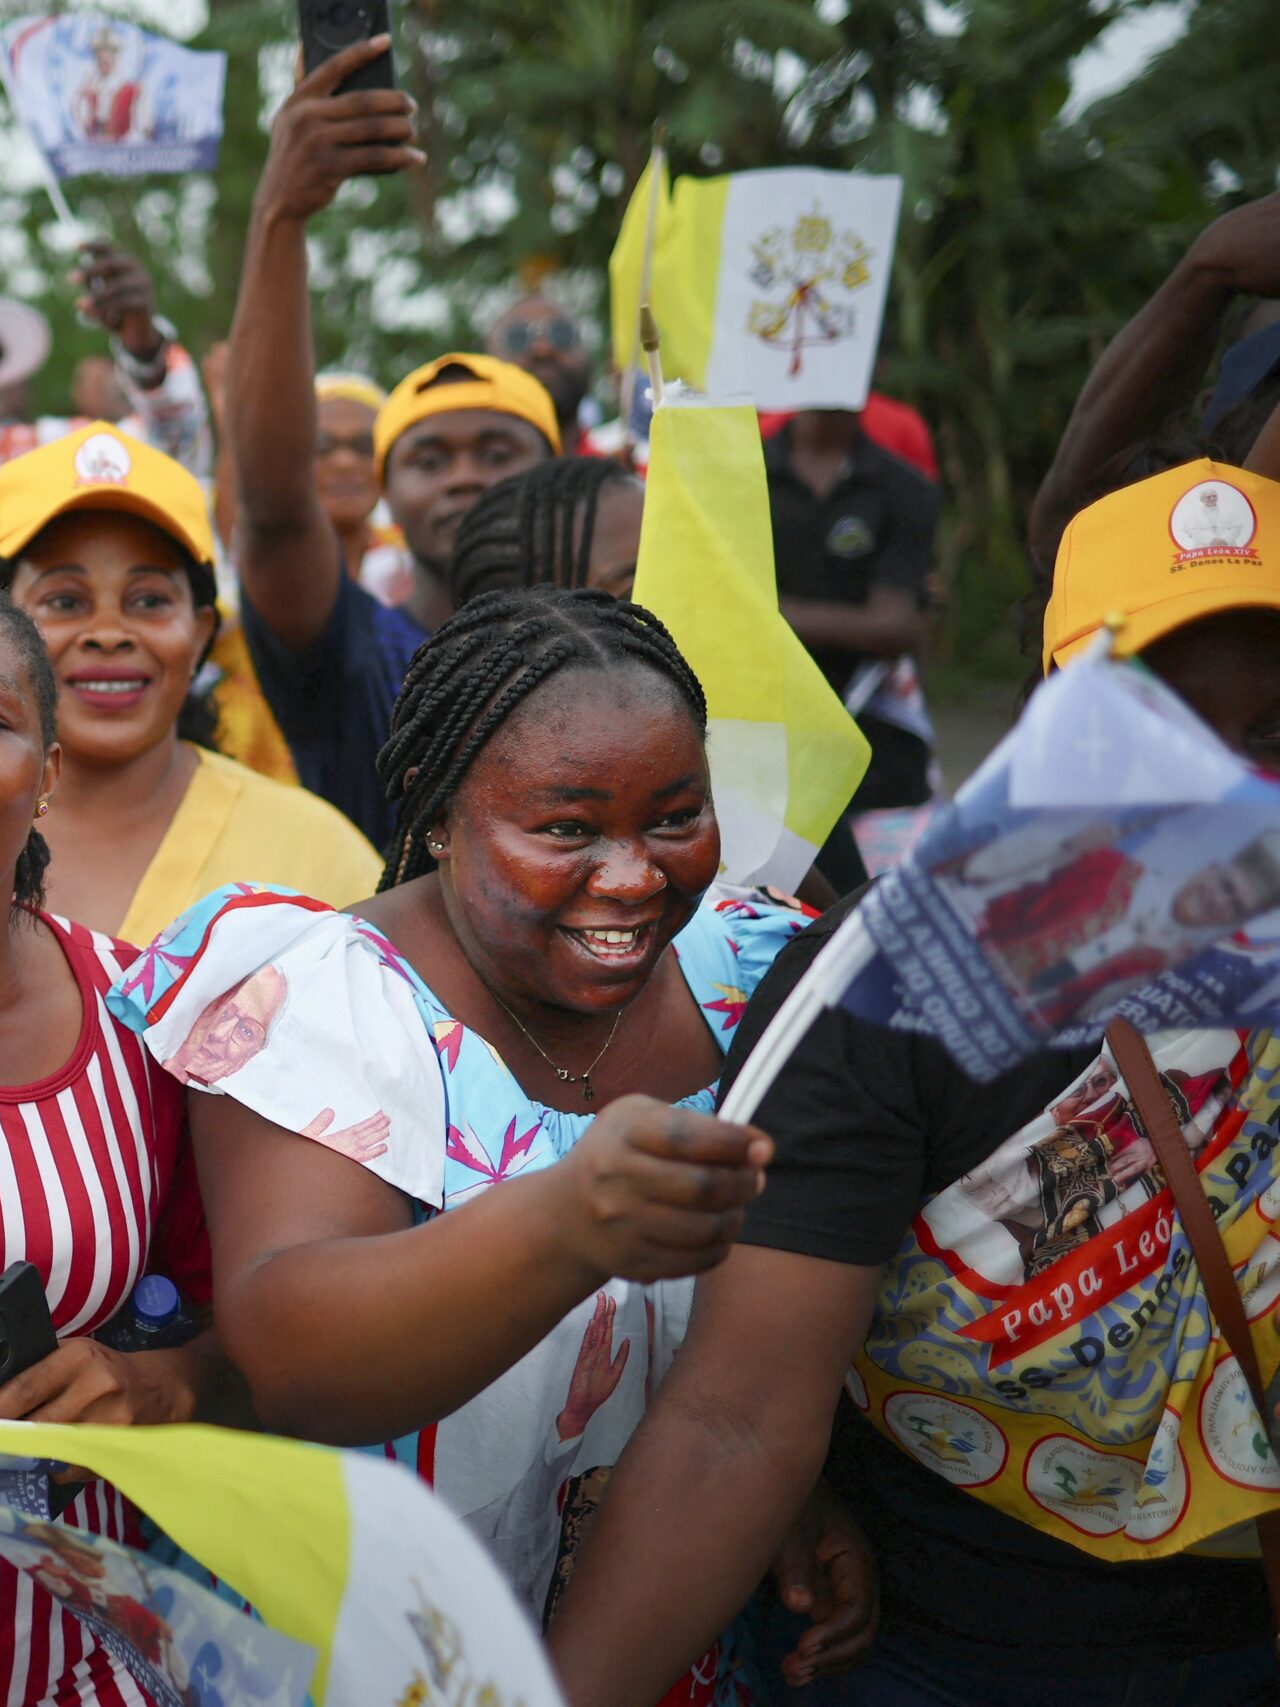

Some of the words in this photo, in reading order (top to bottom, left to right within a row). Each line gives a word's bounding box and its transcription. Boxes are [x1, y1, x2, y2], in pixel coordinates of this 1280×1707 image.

[1170, 564, 1187, 573] SS.
[1190, 558, 1224, 567] Denos
[1243, 558, 1263, 566] Paz
[1180, 550, 1204, 560] Papa
[1000, 1266, 1103, 1343] Papa
[1112, 1207, 1174, 1275] Leó
[995, 1366, 1068, 1400] SS.
[1070, 1247, 1187, 1368] Denos
